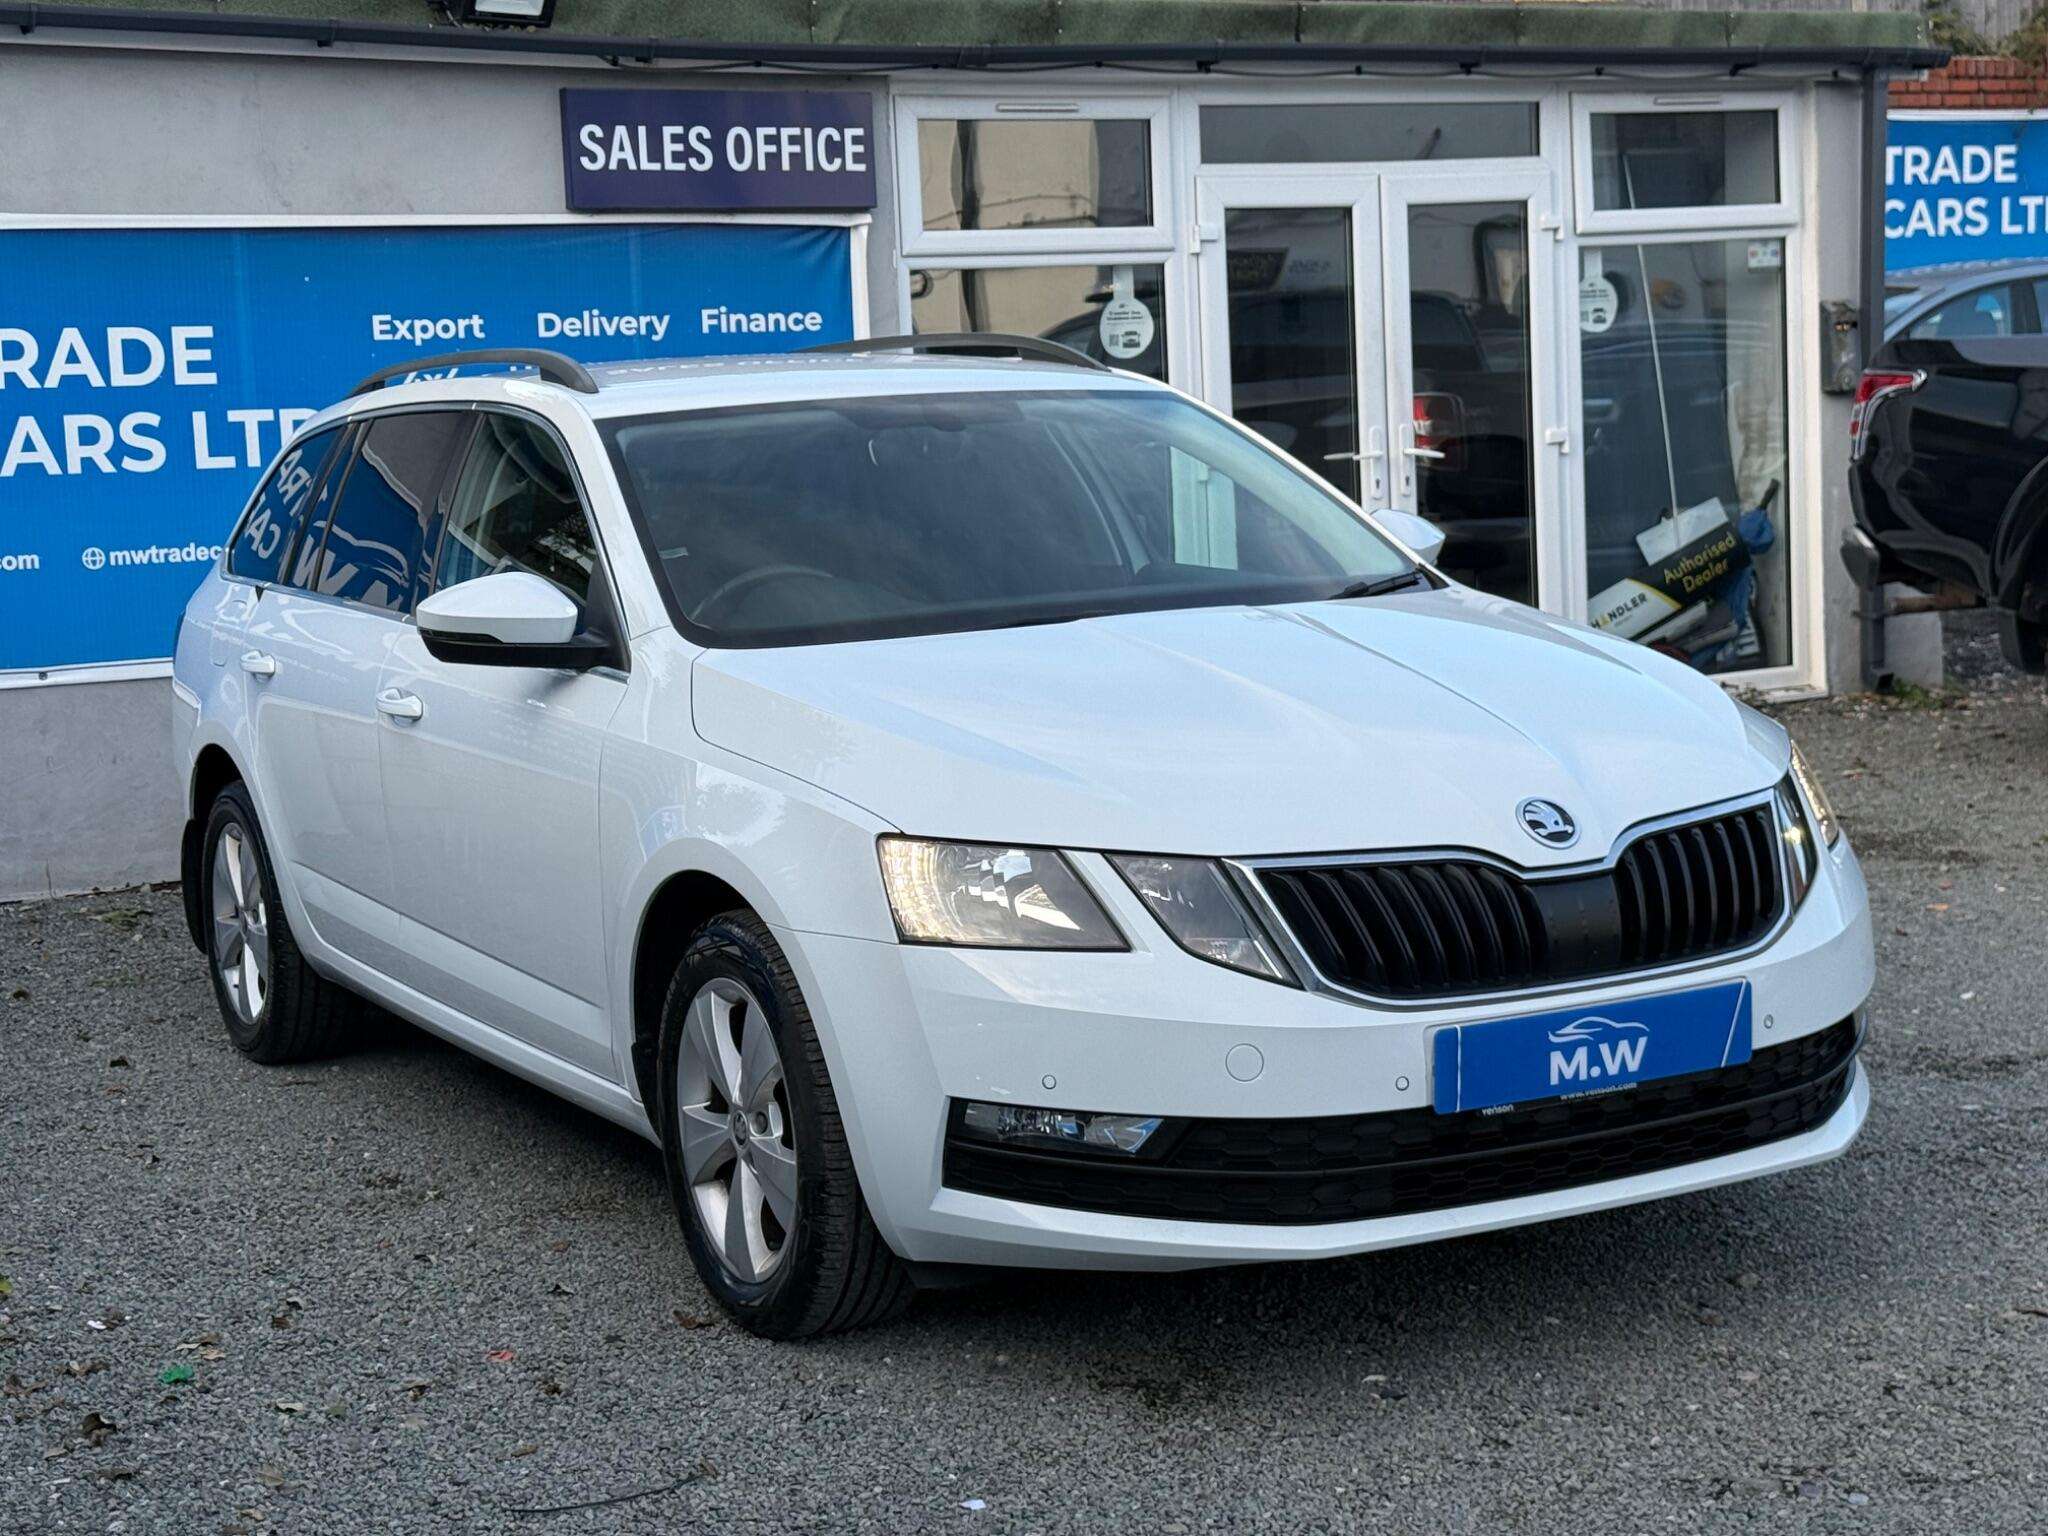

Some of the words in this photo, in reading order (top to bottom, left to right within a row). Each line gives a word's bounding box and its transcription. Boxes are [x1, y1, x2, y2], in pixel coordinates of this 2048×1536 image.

[579, 124, 713, 171] SALES
[726, 126, 867, 172] OFFICE
[1884, 144, 2018, 186] TRADE
[1884, 196, 1990, 239] CARS
[2001, 195, 2048, 235] LT
[371, 314, 485, 346] Export
[537, 309, 670, 341] Delivery
[700, 306, 823, 334] Finance
[0, 411, 167, 477] ARS
[1663, 532, 1736, 584] Authorised
[1681, 558, 1729, 594] Dealer
[1549, 1036, 1649, 1086] M.W
